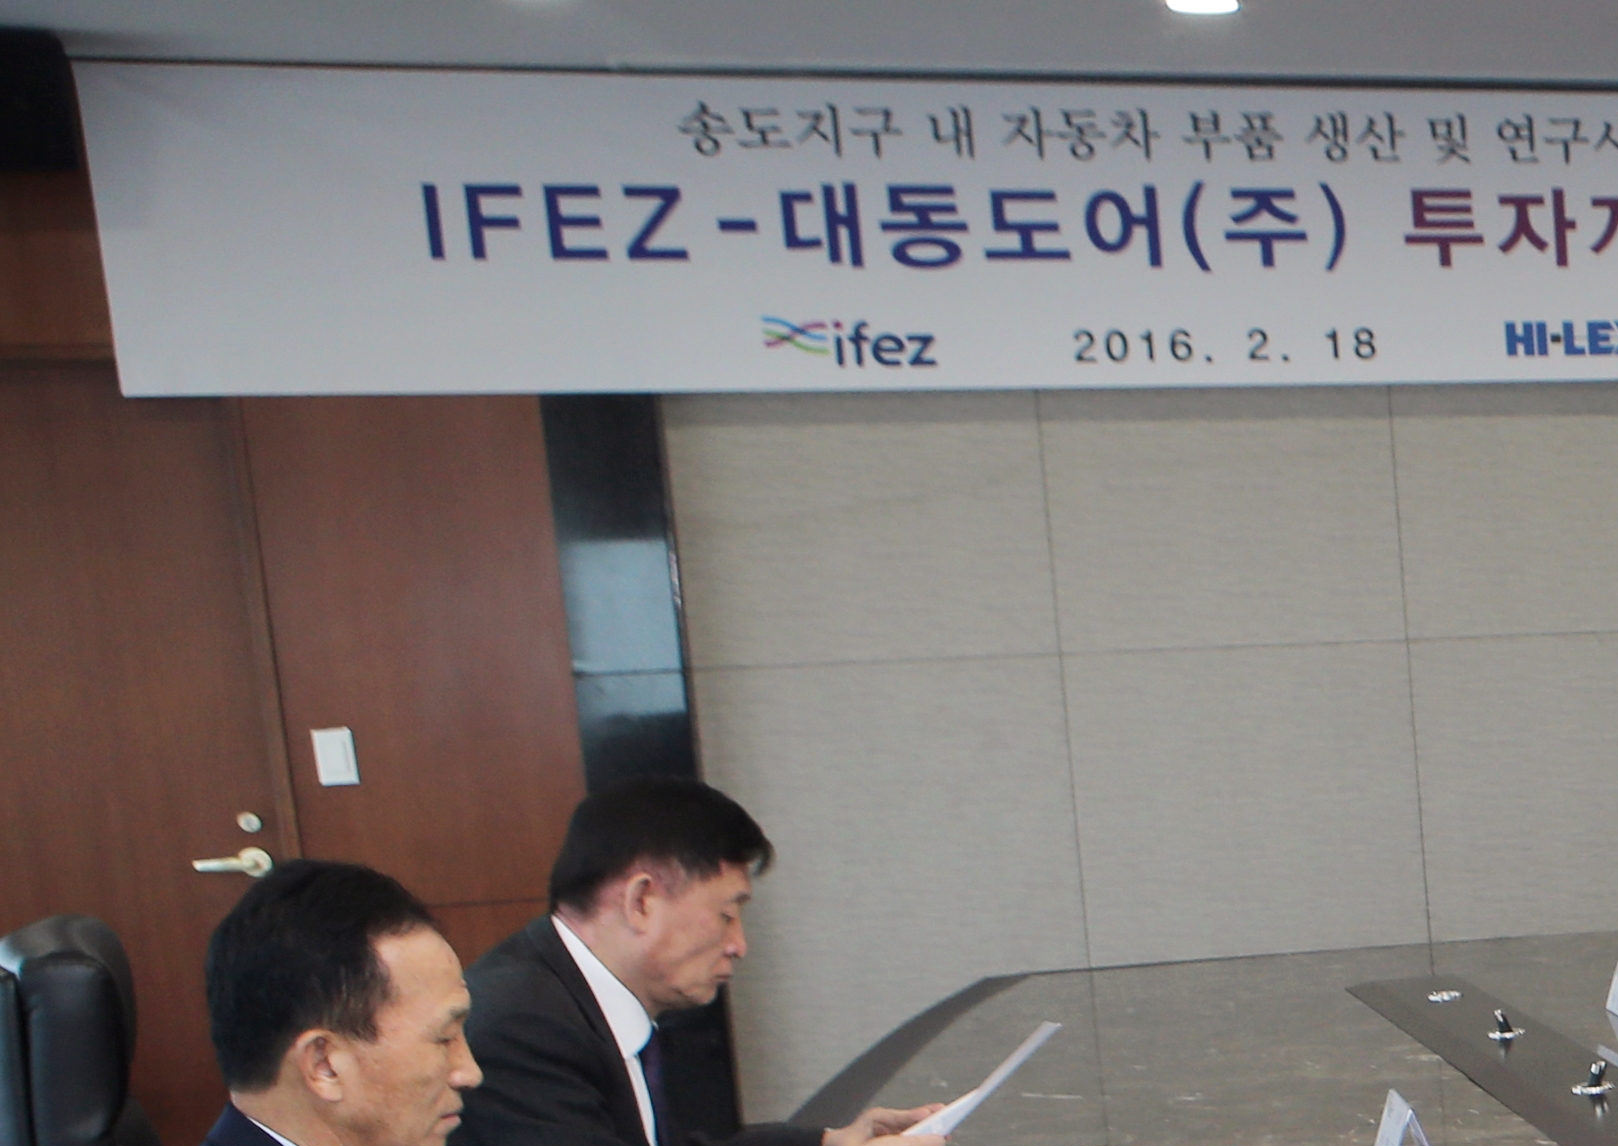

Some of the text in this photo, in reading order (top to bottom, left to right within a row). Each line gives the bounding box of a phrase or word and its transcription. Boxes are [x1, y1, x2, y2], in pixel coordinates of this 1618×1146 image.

[678, 101, 904, 161] 송도지구
[928, 105, 977, 161] 내
[1003, 106, 1162, 163] 자동차
[1183, 110, 1285, 164] 부품
[1308, 111, 1407, 165] 생산
[1428, 113, 1472, 166] 및
[834, 320, 938, 367] ifez
